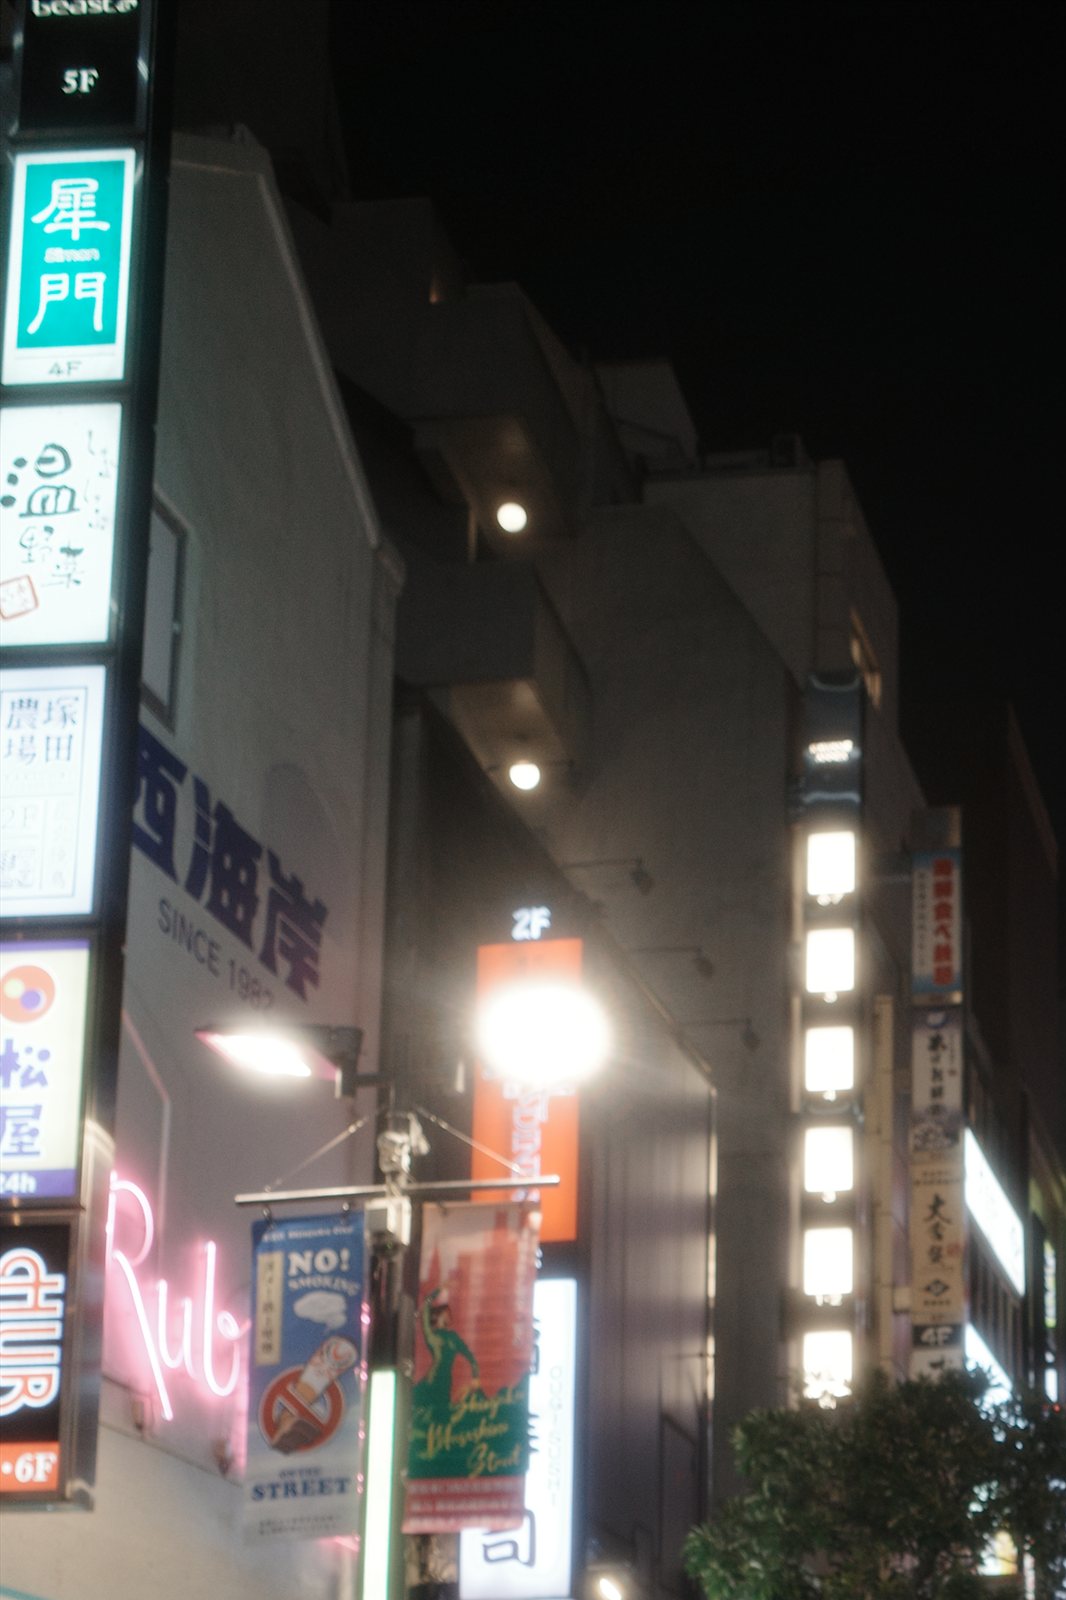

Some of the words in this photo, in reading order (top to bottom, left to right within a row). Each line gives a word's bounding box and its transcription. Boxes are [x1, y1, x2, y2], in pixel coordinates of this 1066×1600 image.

[61, 69, 99, 94] 5F
[48, 361, 82, 376] 4F
[512, 906, 551, 940] 2F
[157, 899, 221, 979] SINCE
[0, 1038, 51, 1157] 松屋
[288, 1249, 350, 1276] NO!
[920, 1326, 953, 1347] 4F
[251, 1477, 350, 1501] STREET
